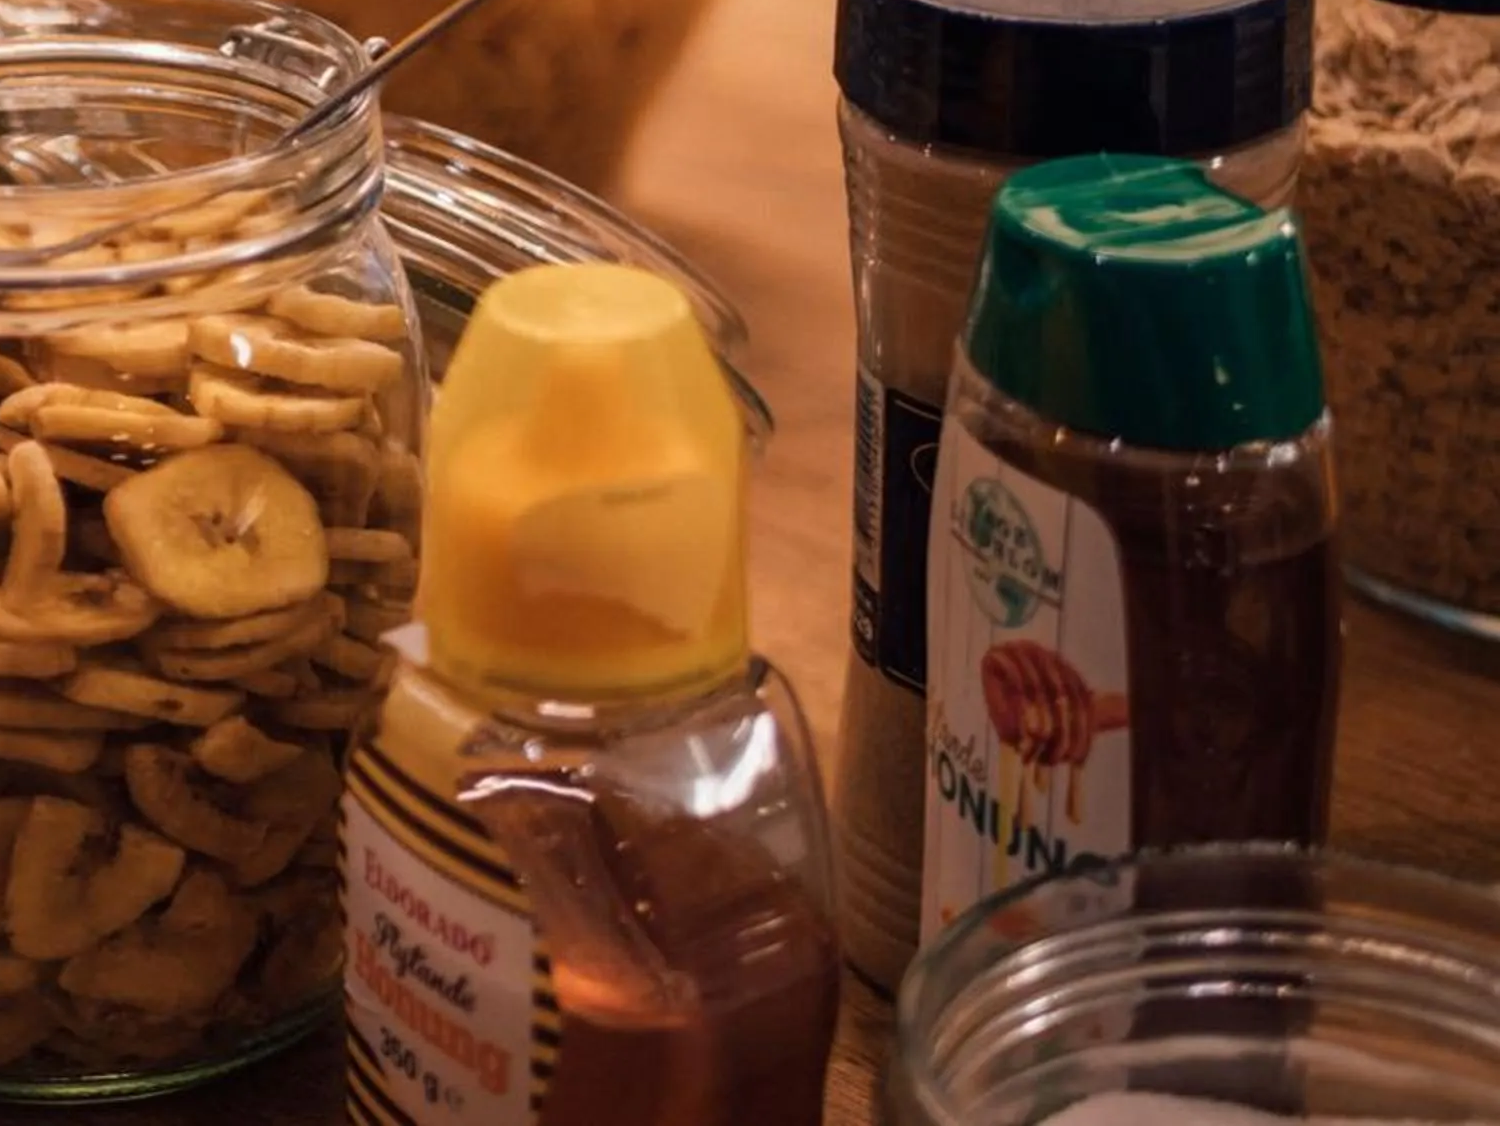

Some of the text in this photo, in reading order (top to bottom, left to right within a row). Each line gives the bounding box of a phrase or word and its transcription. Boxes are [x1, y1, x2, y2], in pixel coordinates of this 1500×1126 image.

[363, 846, 495, 968] ELDORADO
[380, 1026, 417, 1081] 350
[422, 1071, 438, 1104] g
